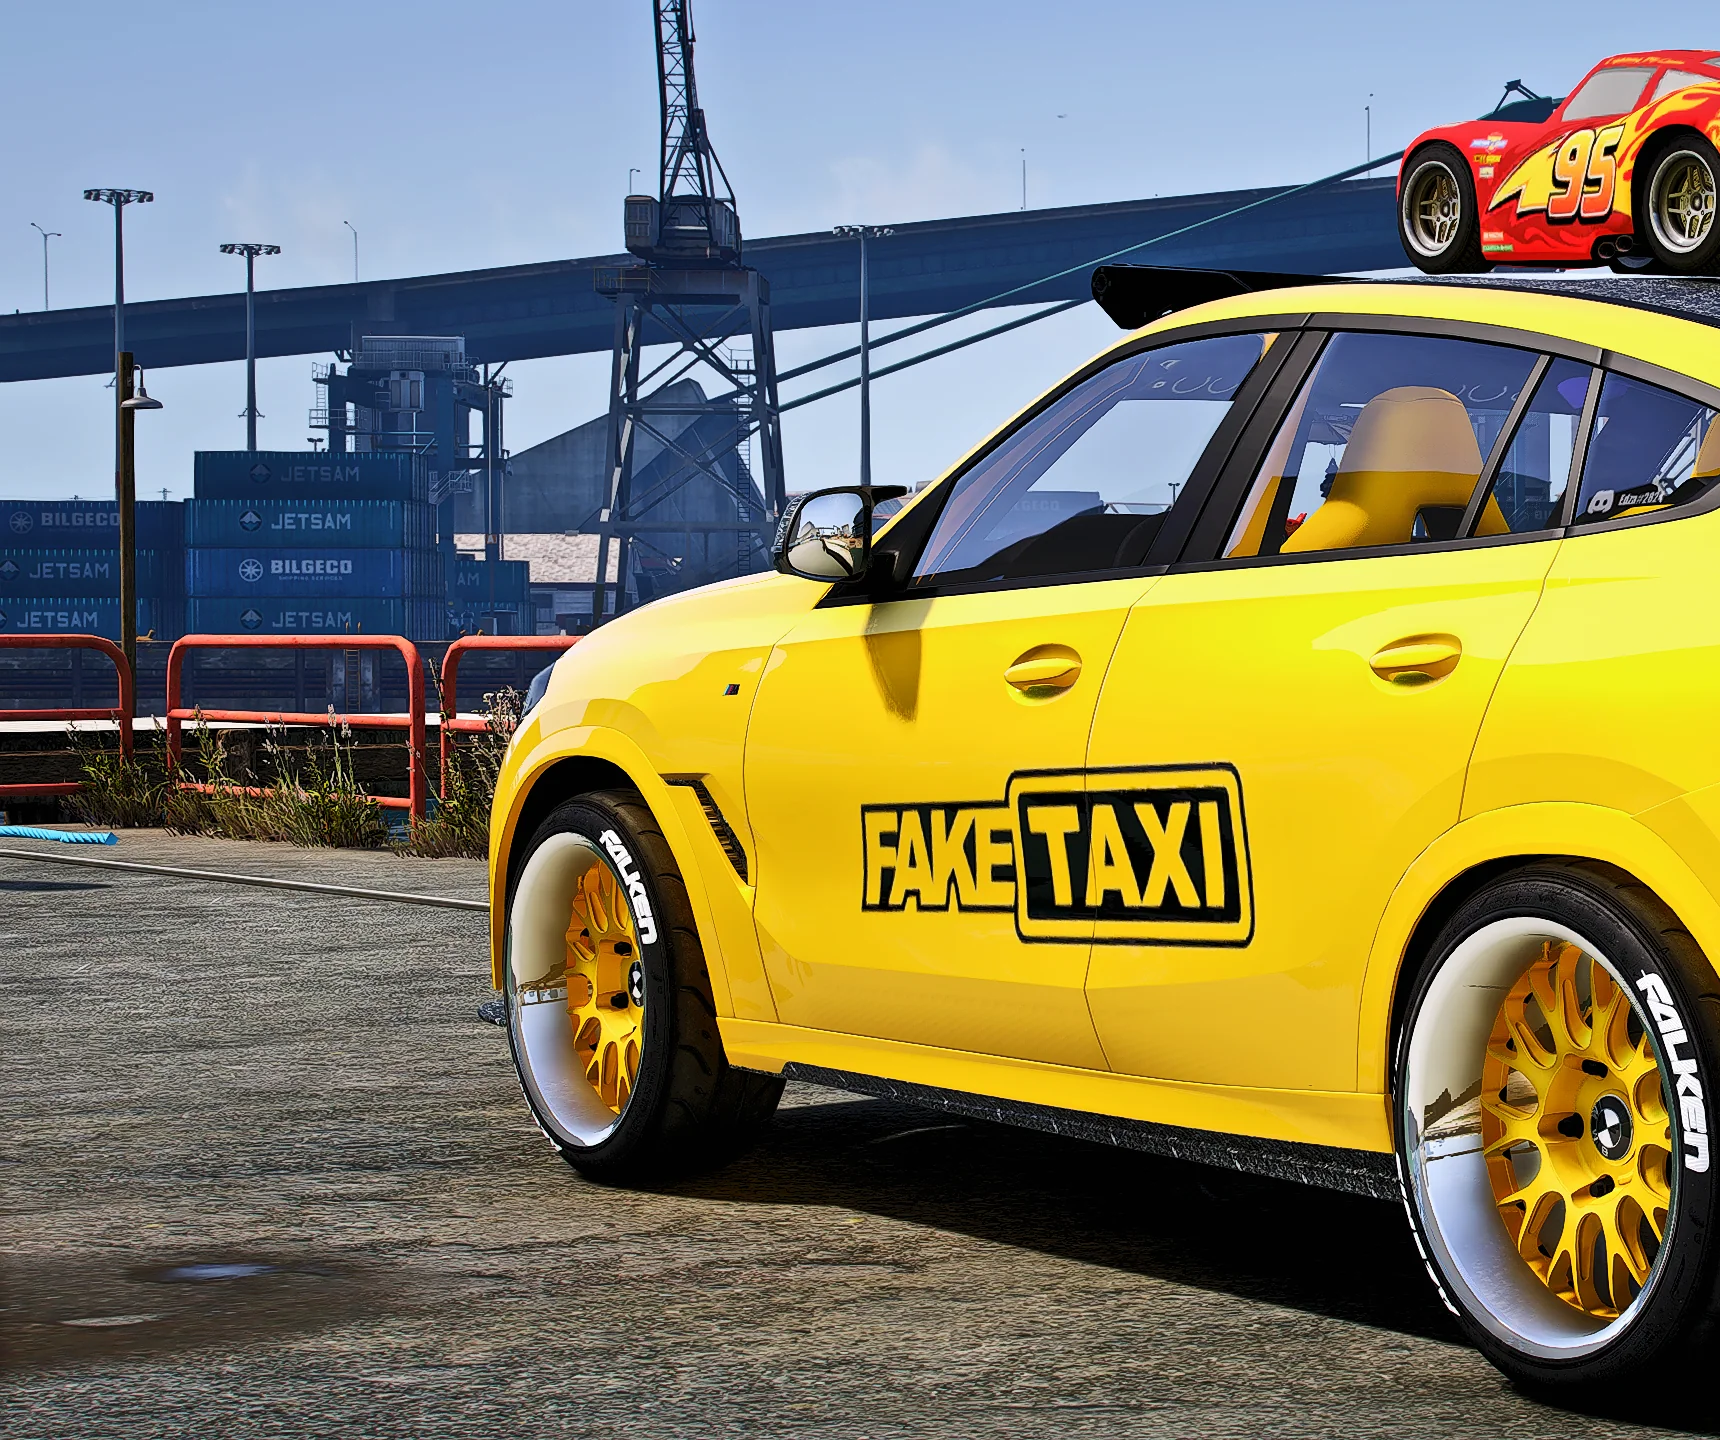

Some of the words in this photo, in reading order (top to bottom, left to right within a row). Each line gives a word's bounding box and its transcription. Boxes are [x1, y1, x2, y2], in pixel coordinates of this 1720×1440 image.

[1548, 124, 1626, 224] 95
[281, 465, 359, 482] JETSAM
[41, 512, 120, 526] BILGECO
[271, 513, 351, 530] JETSAM
[29, 562, 109, 579] JETSAM
[270, 559, 353, 574] BILGECO
[17, 611, 98, 628] JETSAM
[272, 611, 352, 628] JETSAM
[861, 802, 1017, 912] FAKE
[1026, 800, 1226, 910] TAXI
[599, 829, 657, 945] FALKEN
[1635, 969, 1710, 1173] FALKEN
